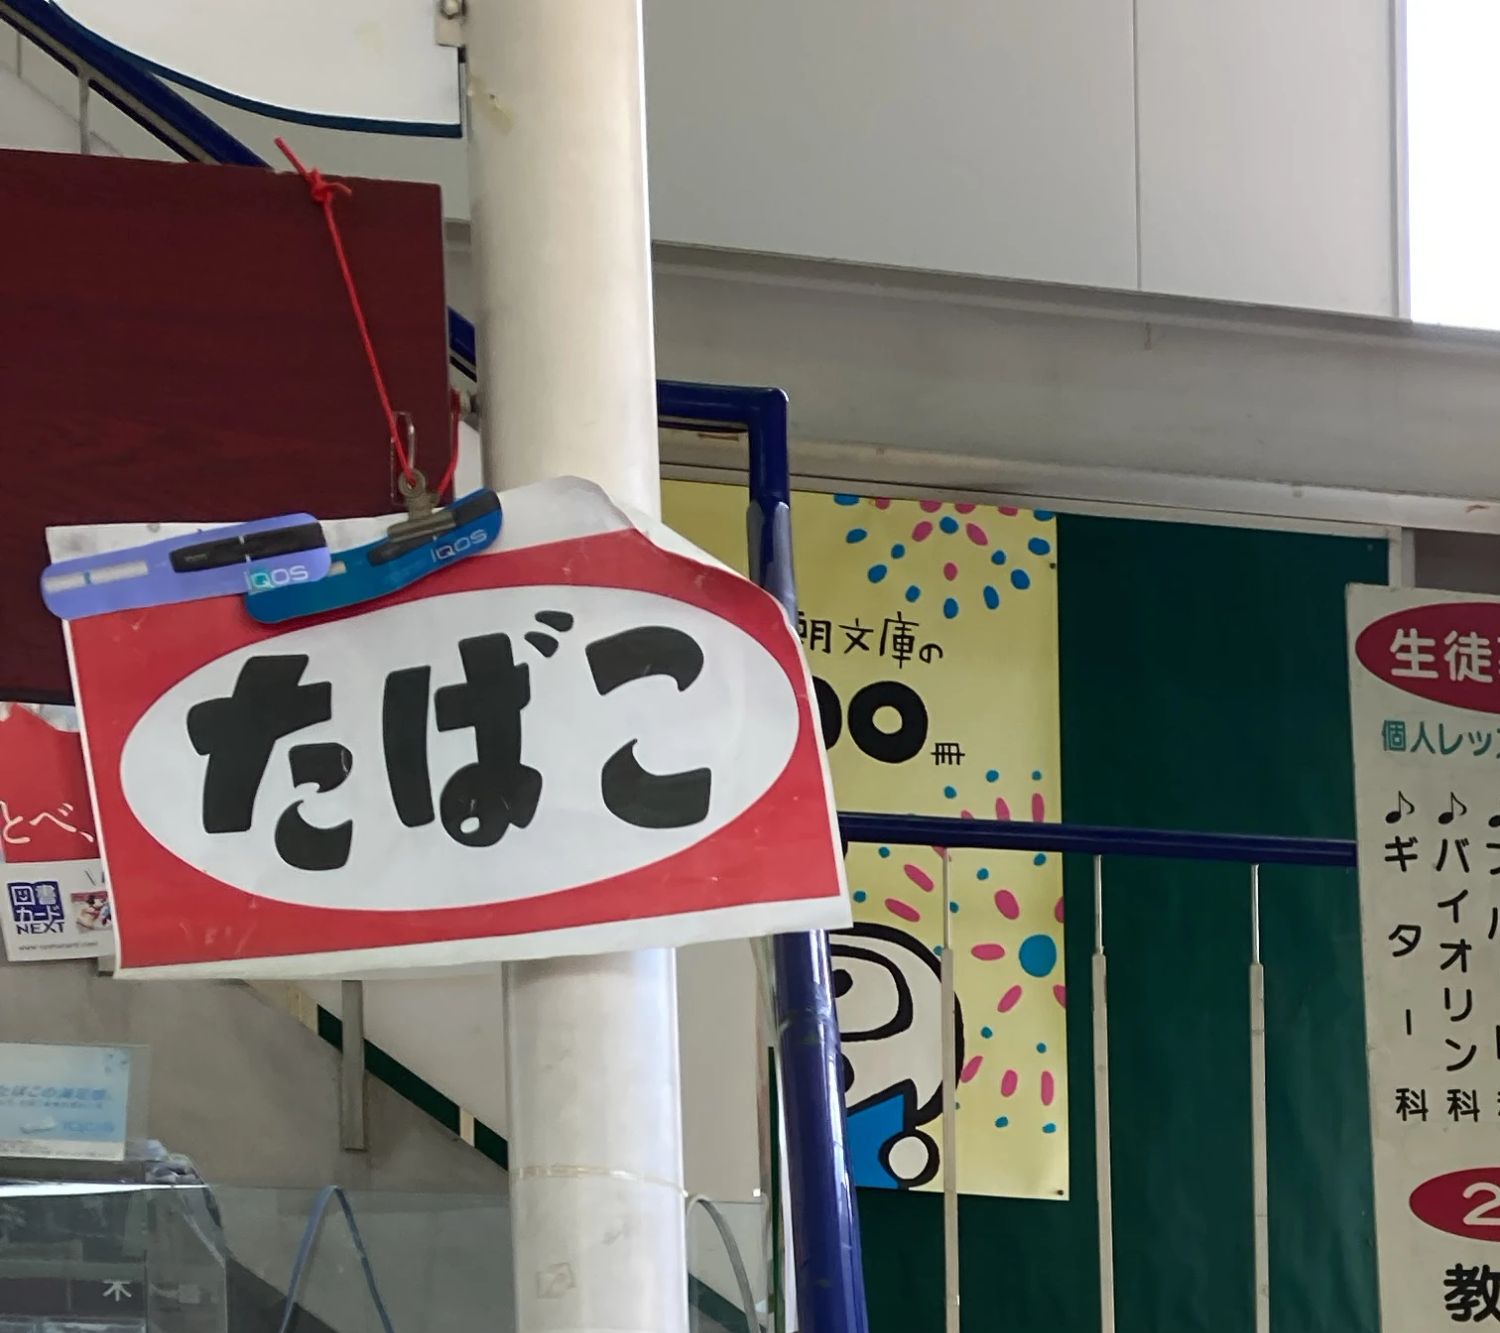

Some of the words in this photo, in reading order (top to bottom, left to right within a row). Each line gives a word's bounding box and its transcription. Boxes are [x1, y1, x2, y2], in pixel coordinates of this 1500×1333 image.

[246, 564, 309, 591] IQOS
[432, 528, 488, 563] IQOS
[187, 610, 712, 871] たばこ
[16, 920, 65, 935] NEXT
[1384, 836, 1428, 1122] ギター科
[1435, 838, 1480, 1122] バイオリン科
